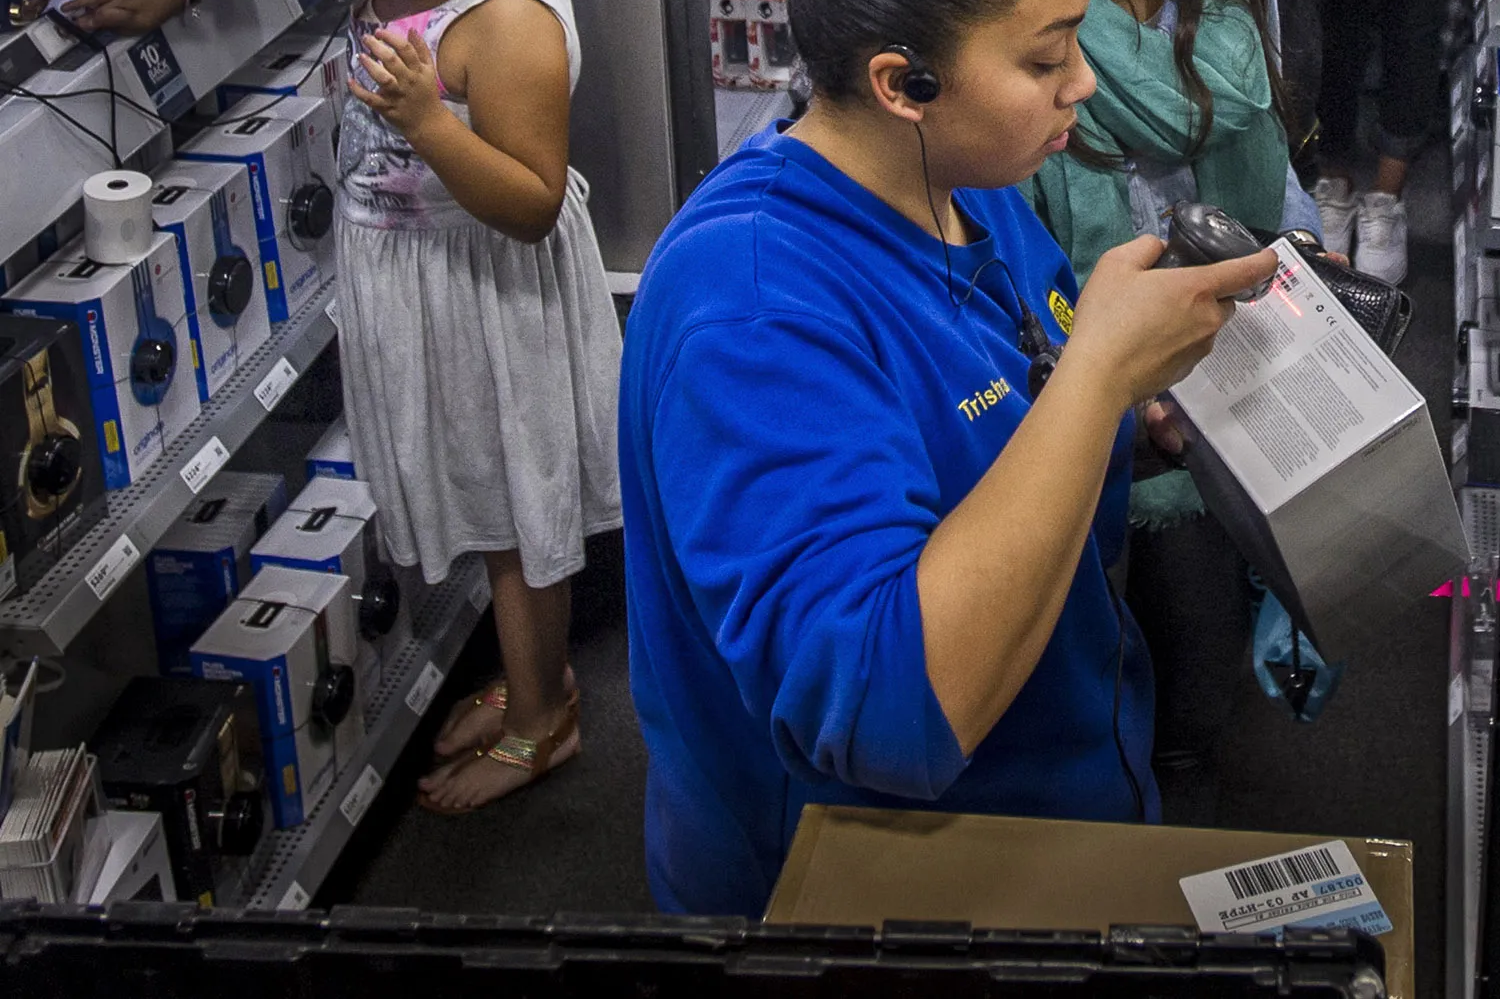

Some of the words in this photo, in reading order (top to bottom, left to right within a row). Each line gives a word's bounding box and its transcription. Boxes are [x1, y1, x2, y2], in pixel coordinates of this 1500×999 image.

[140, 45, 160, 69] 10
[88, 323, 104, 375] MONSTER
[1291, 888, 1310, 901] AP
